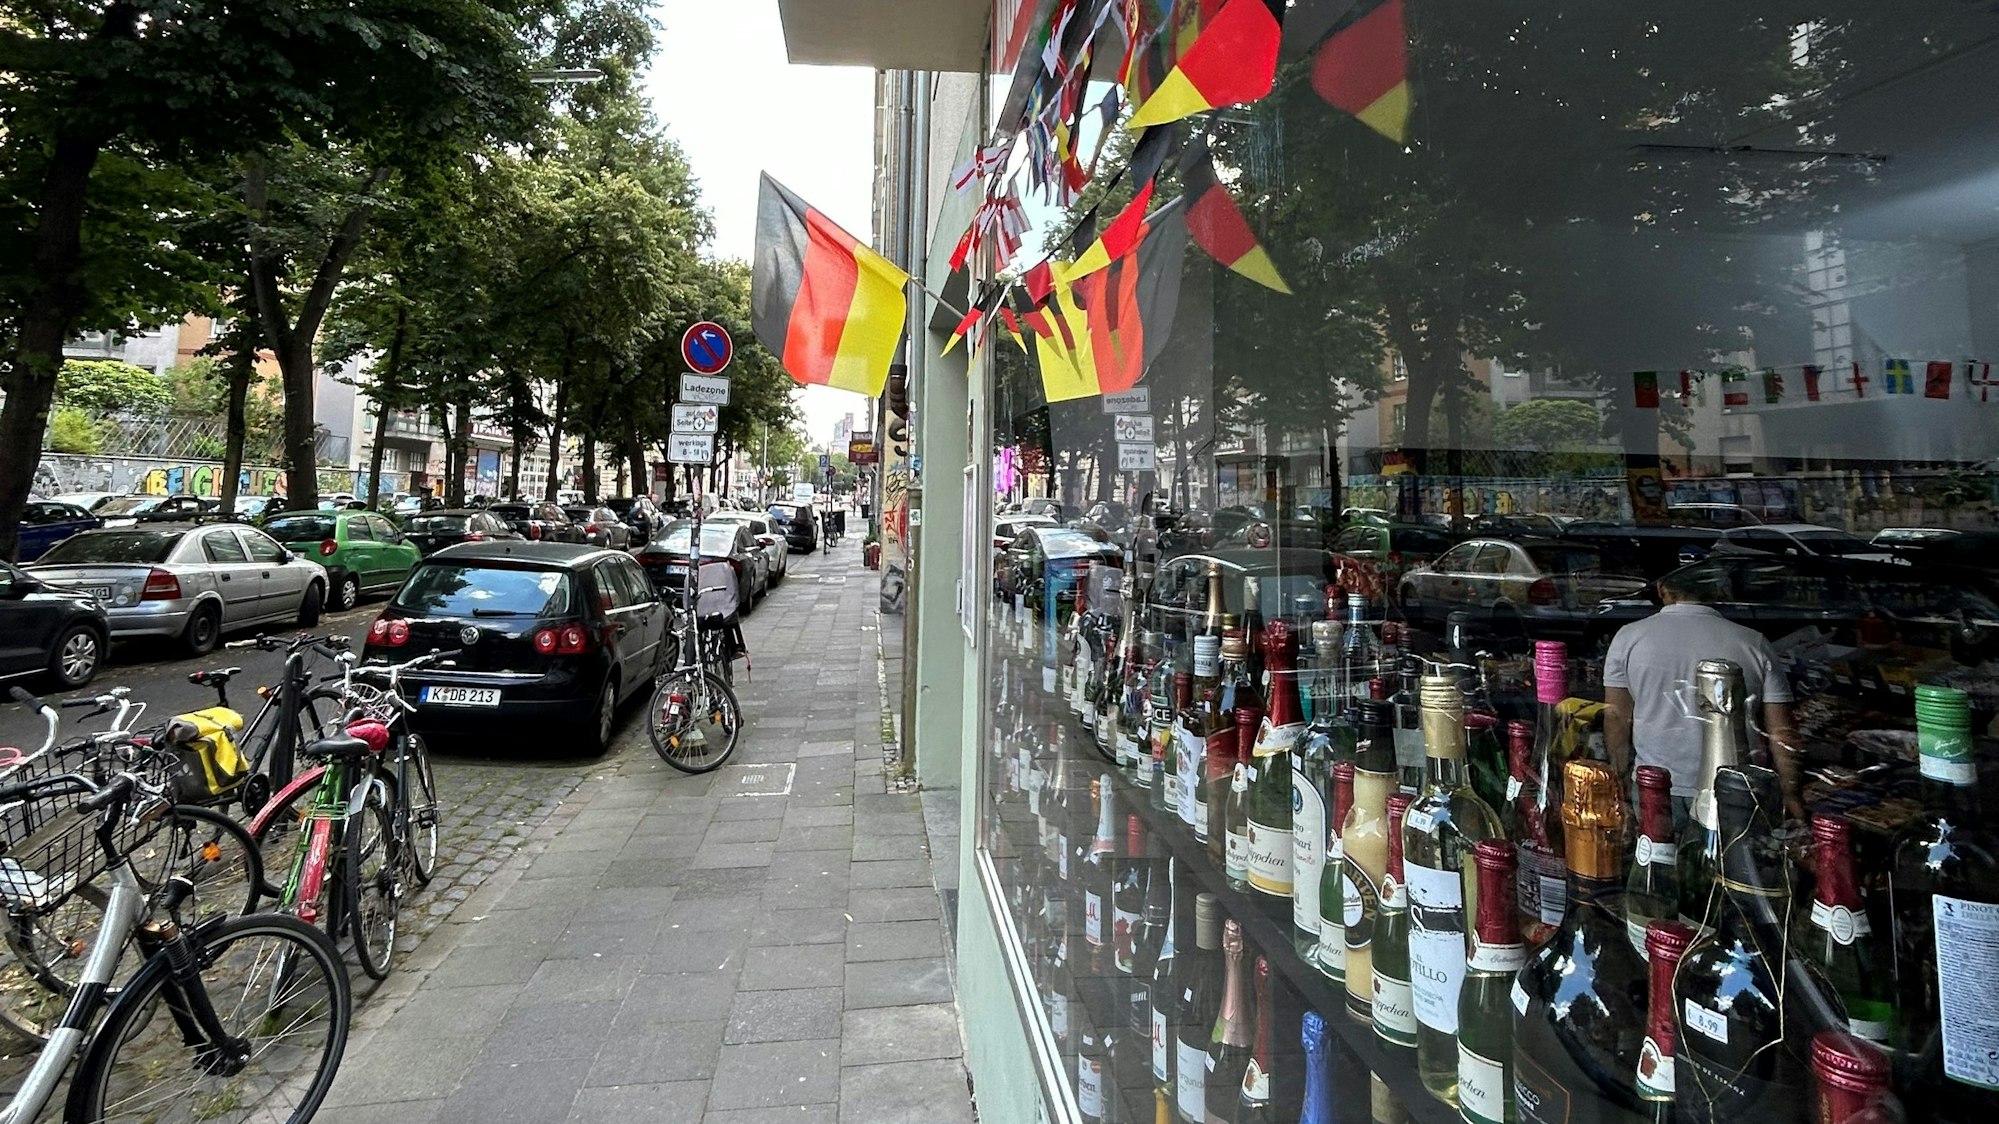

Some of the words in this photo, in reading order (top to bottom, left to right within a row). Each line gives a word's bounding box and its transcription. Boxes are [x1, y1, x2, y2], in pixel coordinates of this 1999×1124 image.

[685, 383, 726, 395] Ladezone
[432, 688, 443, 701] K
[450, 689, 467, 701] DB
[469, 690, 495, 703] 213
[1960, 901, 1994, 914] PINOT
[1699, 1015, 1719, 1034] 8.99
